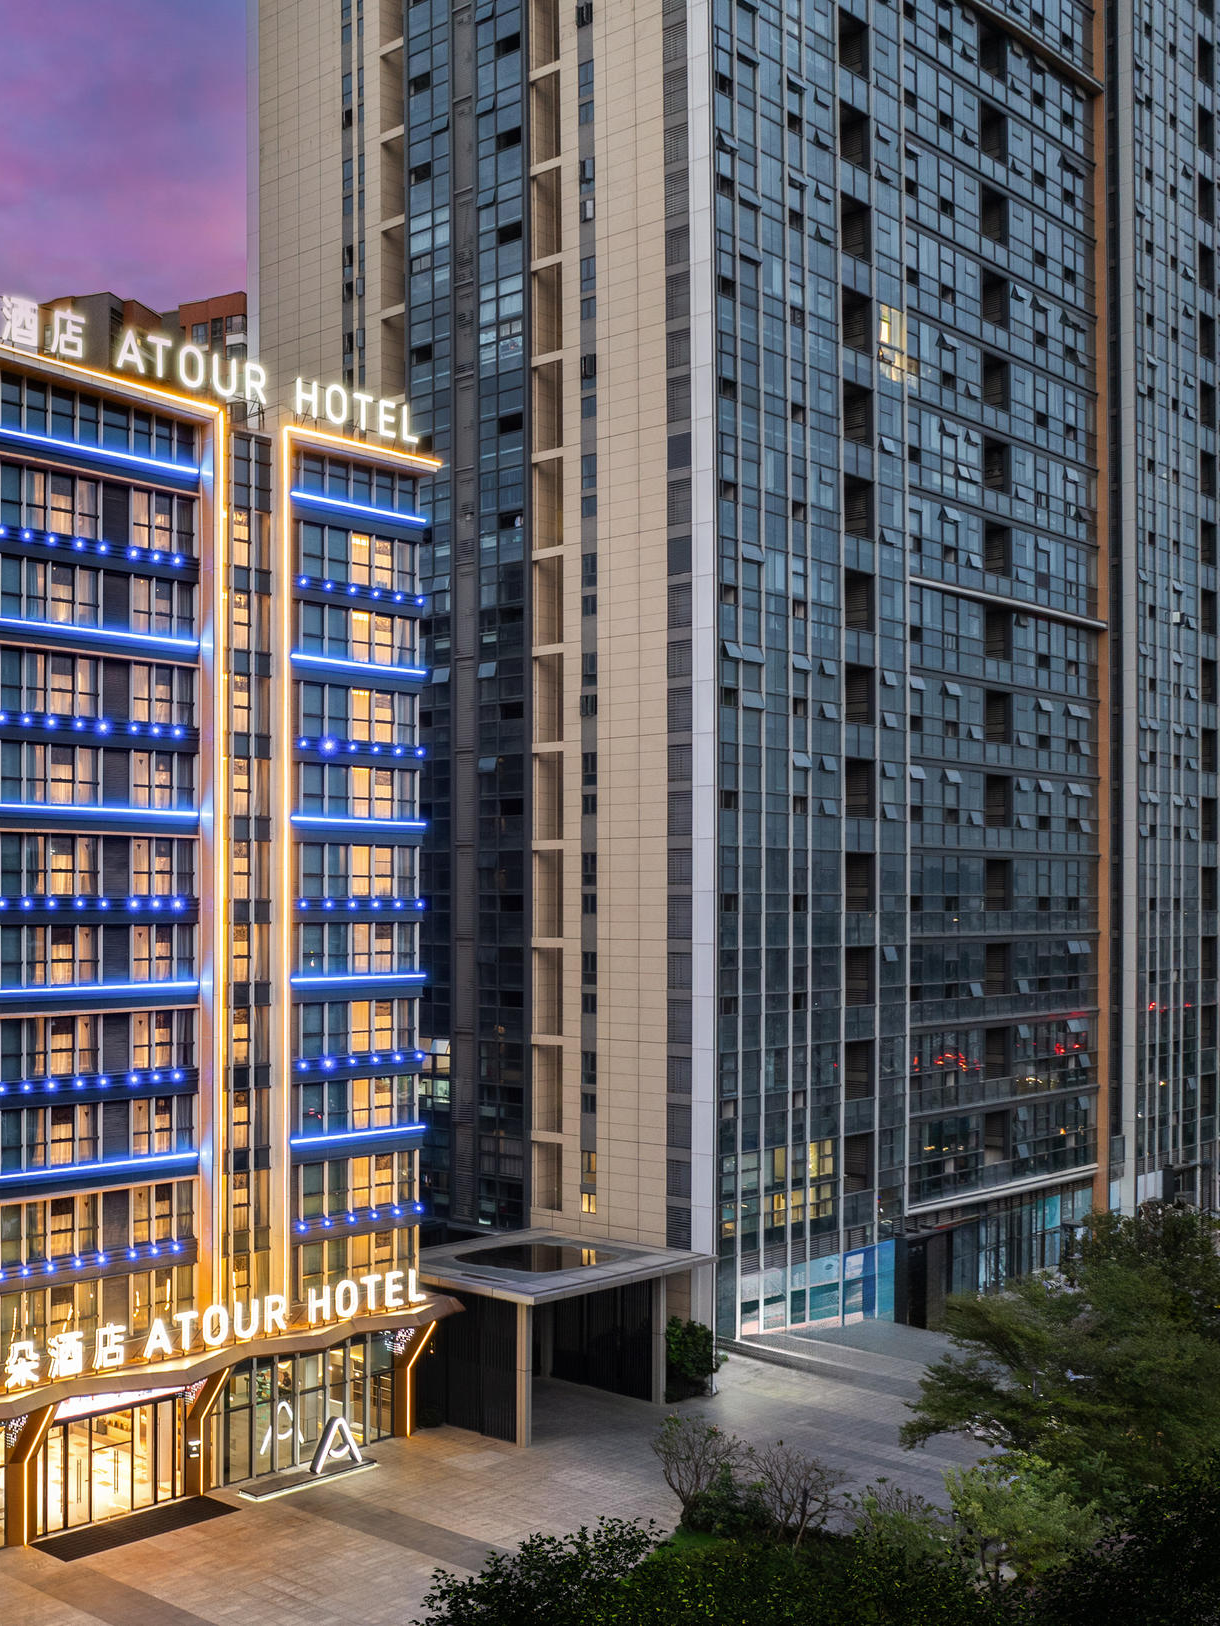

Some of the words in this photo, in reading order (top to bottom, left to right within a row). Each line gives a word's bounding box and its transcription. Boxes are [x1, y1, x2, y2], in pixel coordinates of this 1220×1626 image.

[116, 329, 267, 404] ATOUR
[295, 377, 419, 443] HOTEL
[143, 1294, 287, 1359] ATOUR
[307, 1268, 426, 1322] HOTEL
